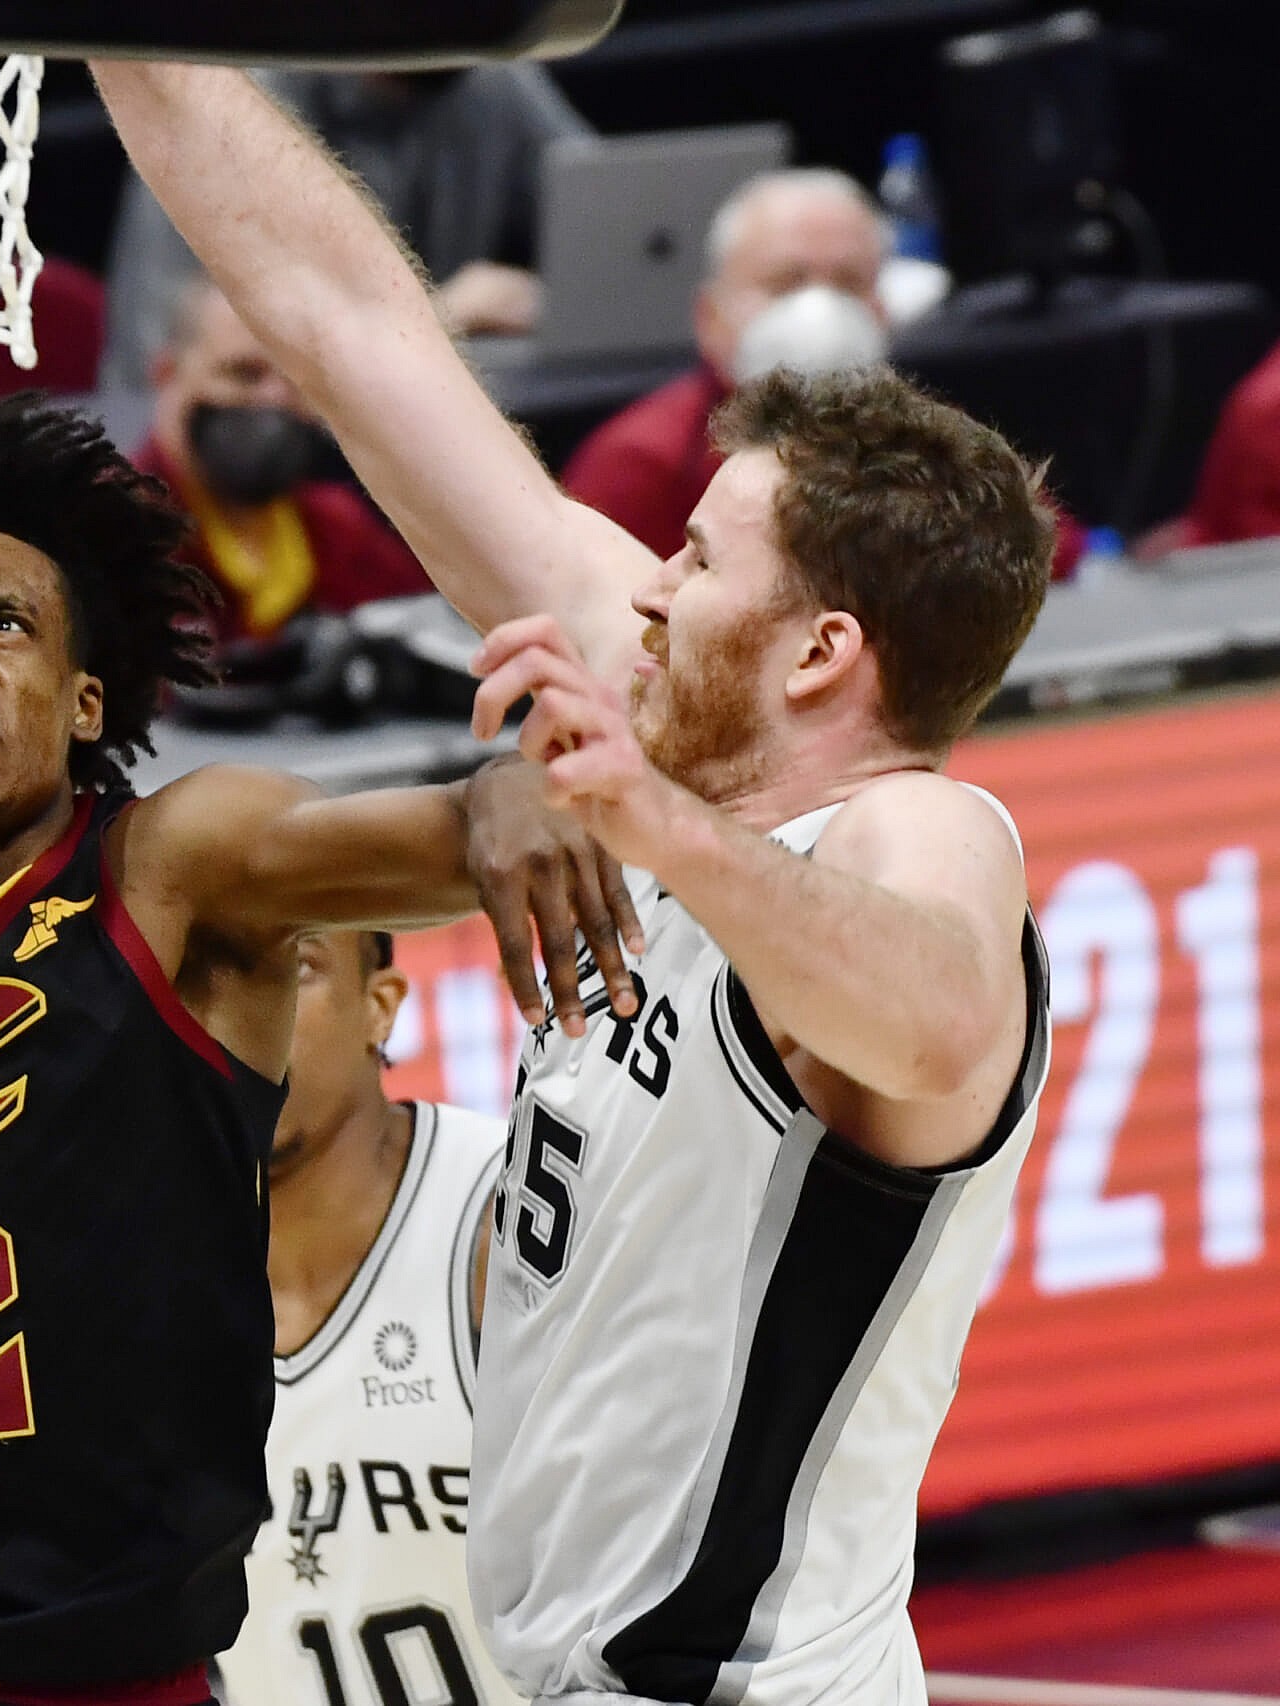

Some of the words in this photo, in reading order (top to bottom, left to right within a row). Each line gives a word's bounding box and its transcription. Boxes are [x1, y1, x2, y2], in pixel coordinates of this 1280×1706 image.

[977, 846, 1265, 1314] 21
[494, 1062, 589, 1289] 5
[361, 1376, 437, 1408] Frost
[293, 1598, 488, 1706] 10
